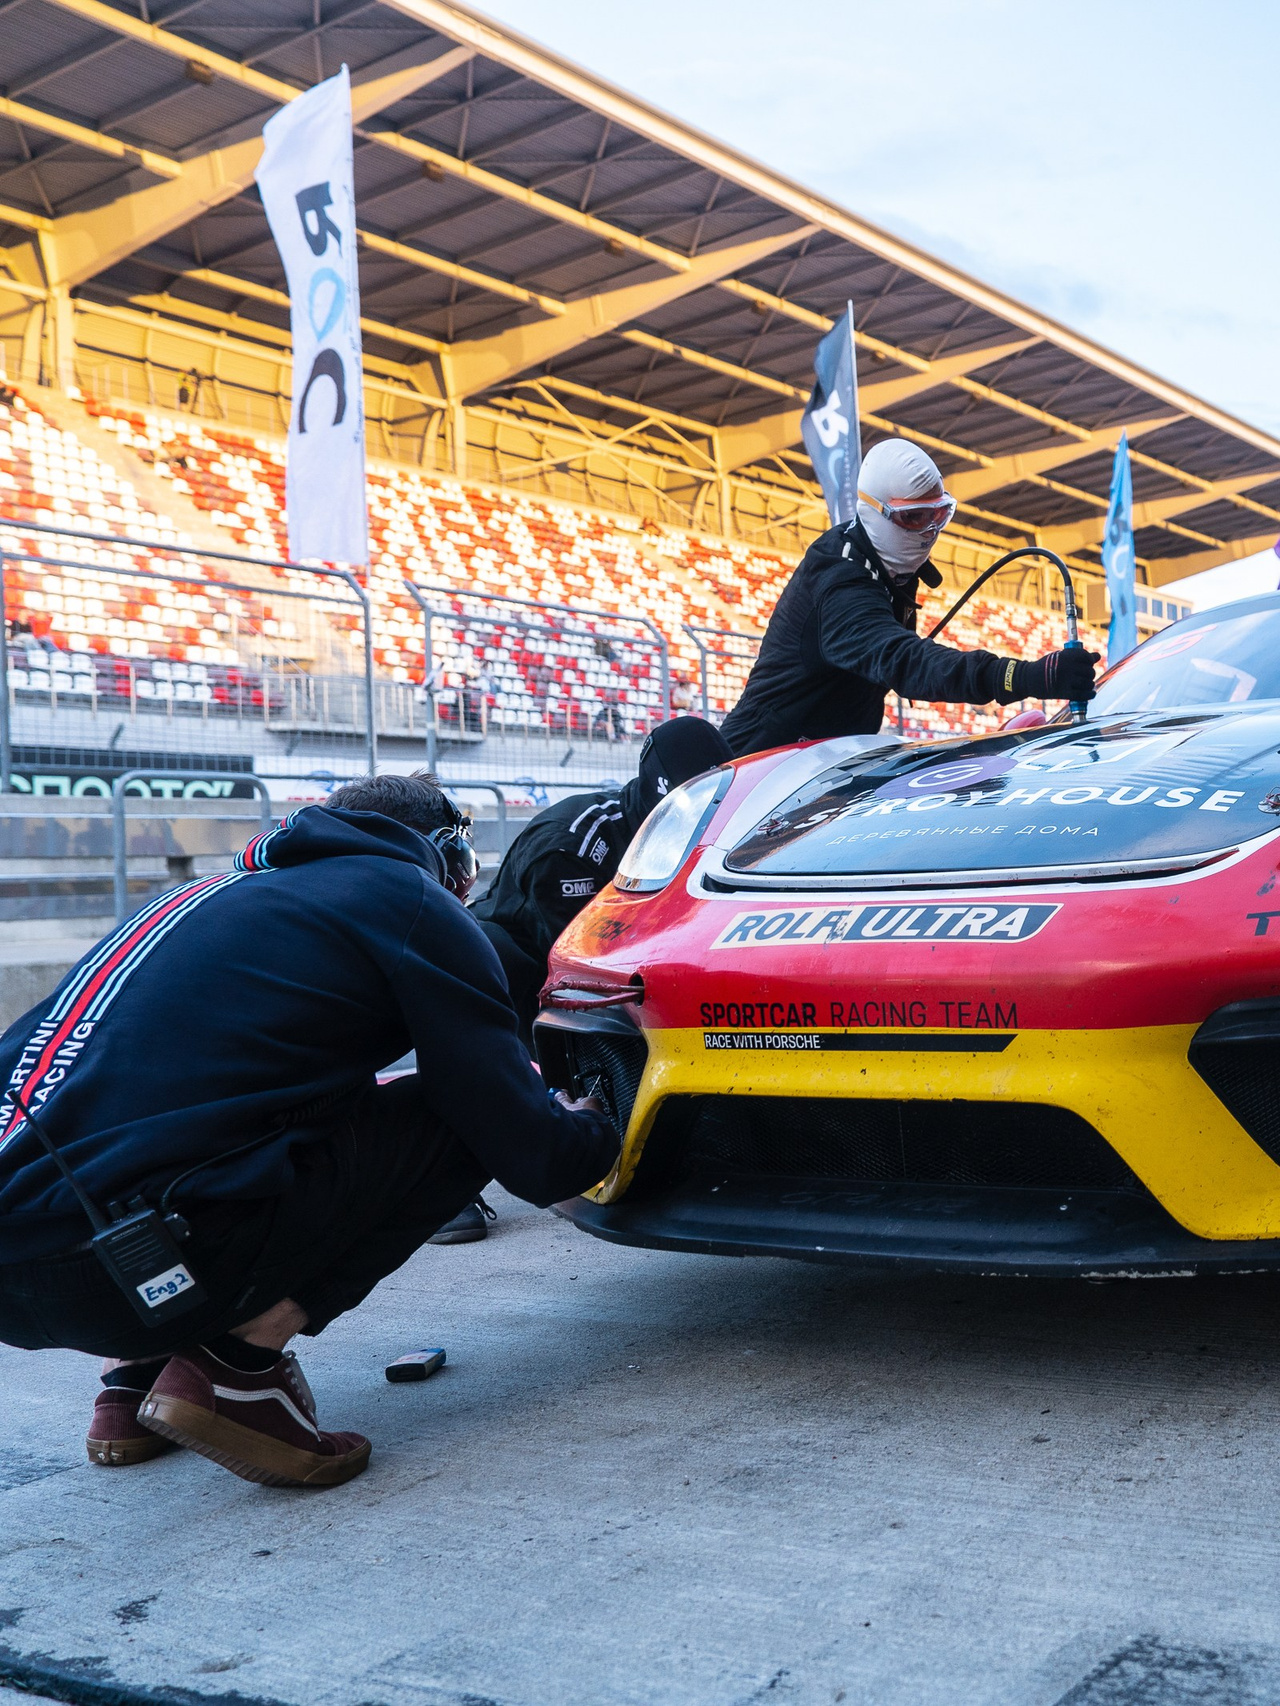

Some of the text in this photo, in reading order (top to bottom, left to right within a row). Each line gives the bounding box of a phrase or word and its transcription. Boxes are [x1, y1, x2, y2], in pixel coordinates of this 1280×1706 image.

[826, 824, 1099, 846] ДЕРЕВЯННЫЕ ДОМА
[592, 839, 608, 863] OMP
[562, 881, 595, 895] OMP
[861, 907, 1030, 938] ULTRA
[700, 1001, 1018, 1029] SPORTCAR RACING TEAM
[705, 1034, 821, 1049] RACE WITH PORSCHE
